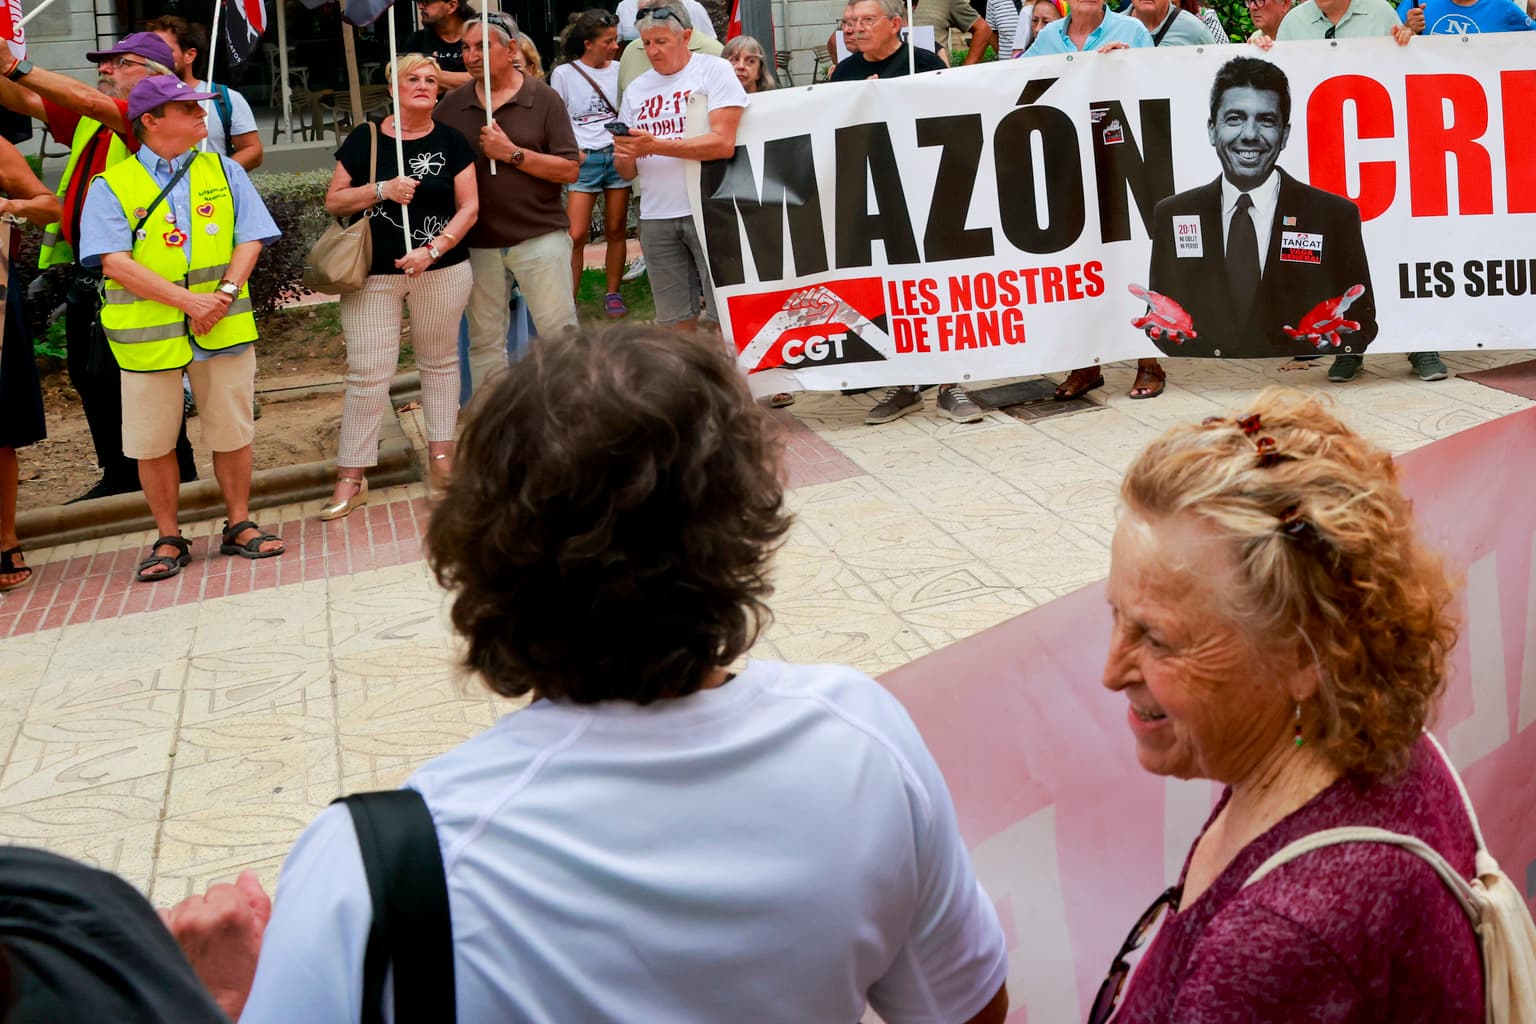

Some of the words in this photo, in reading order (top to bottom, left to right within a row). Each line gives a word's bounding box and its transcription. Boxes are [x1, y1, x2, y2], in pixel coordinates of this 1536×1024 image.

[701, 78, 1175, 287] MAZÓN
[1178, 224, 1198, 234] 20:11
[1283, 239, 1321, 248] TANCAT
[888, 278, 941, 316] LES
[950, 261, 1105, 312] NOSTRES
[1398, 262, 1455, 299] LES
[892, 317, 931, 353] DE
[937, 307, 1026, 352] FANG
[781, 334, 848, 365] CGT
